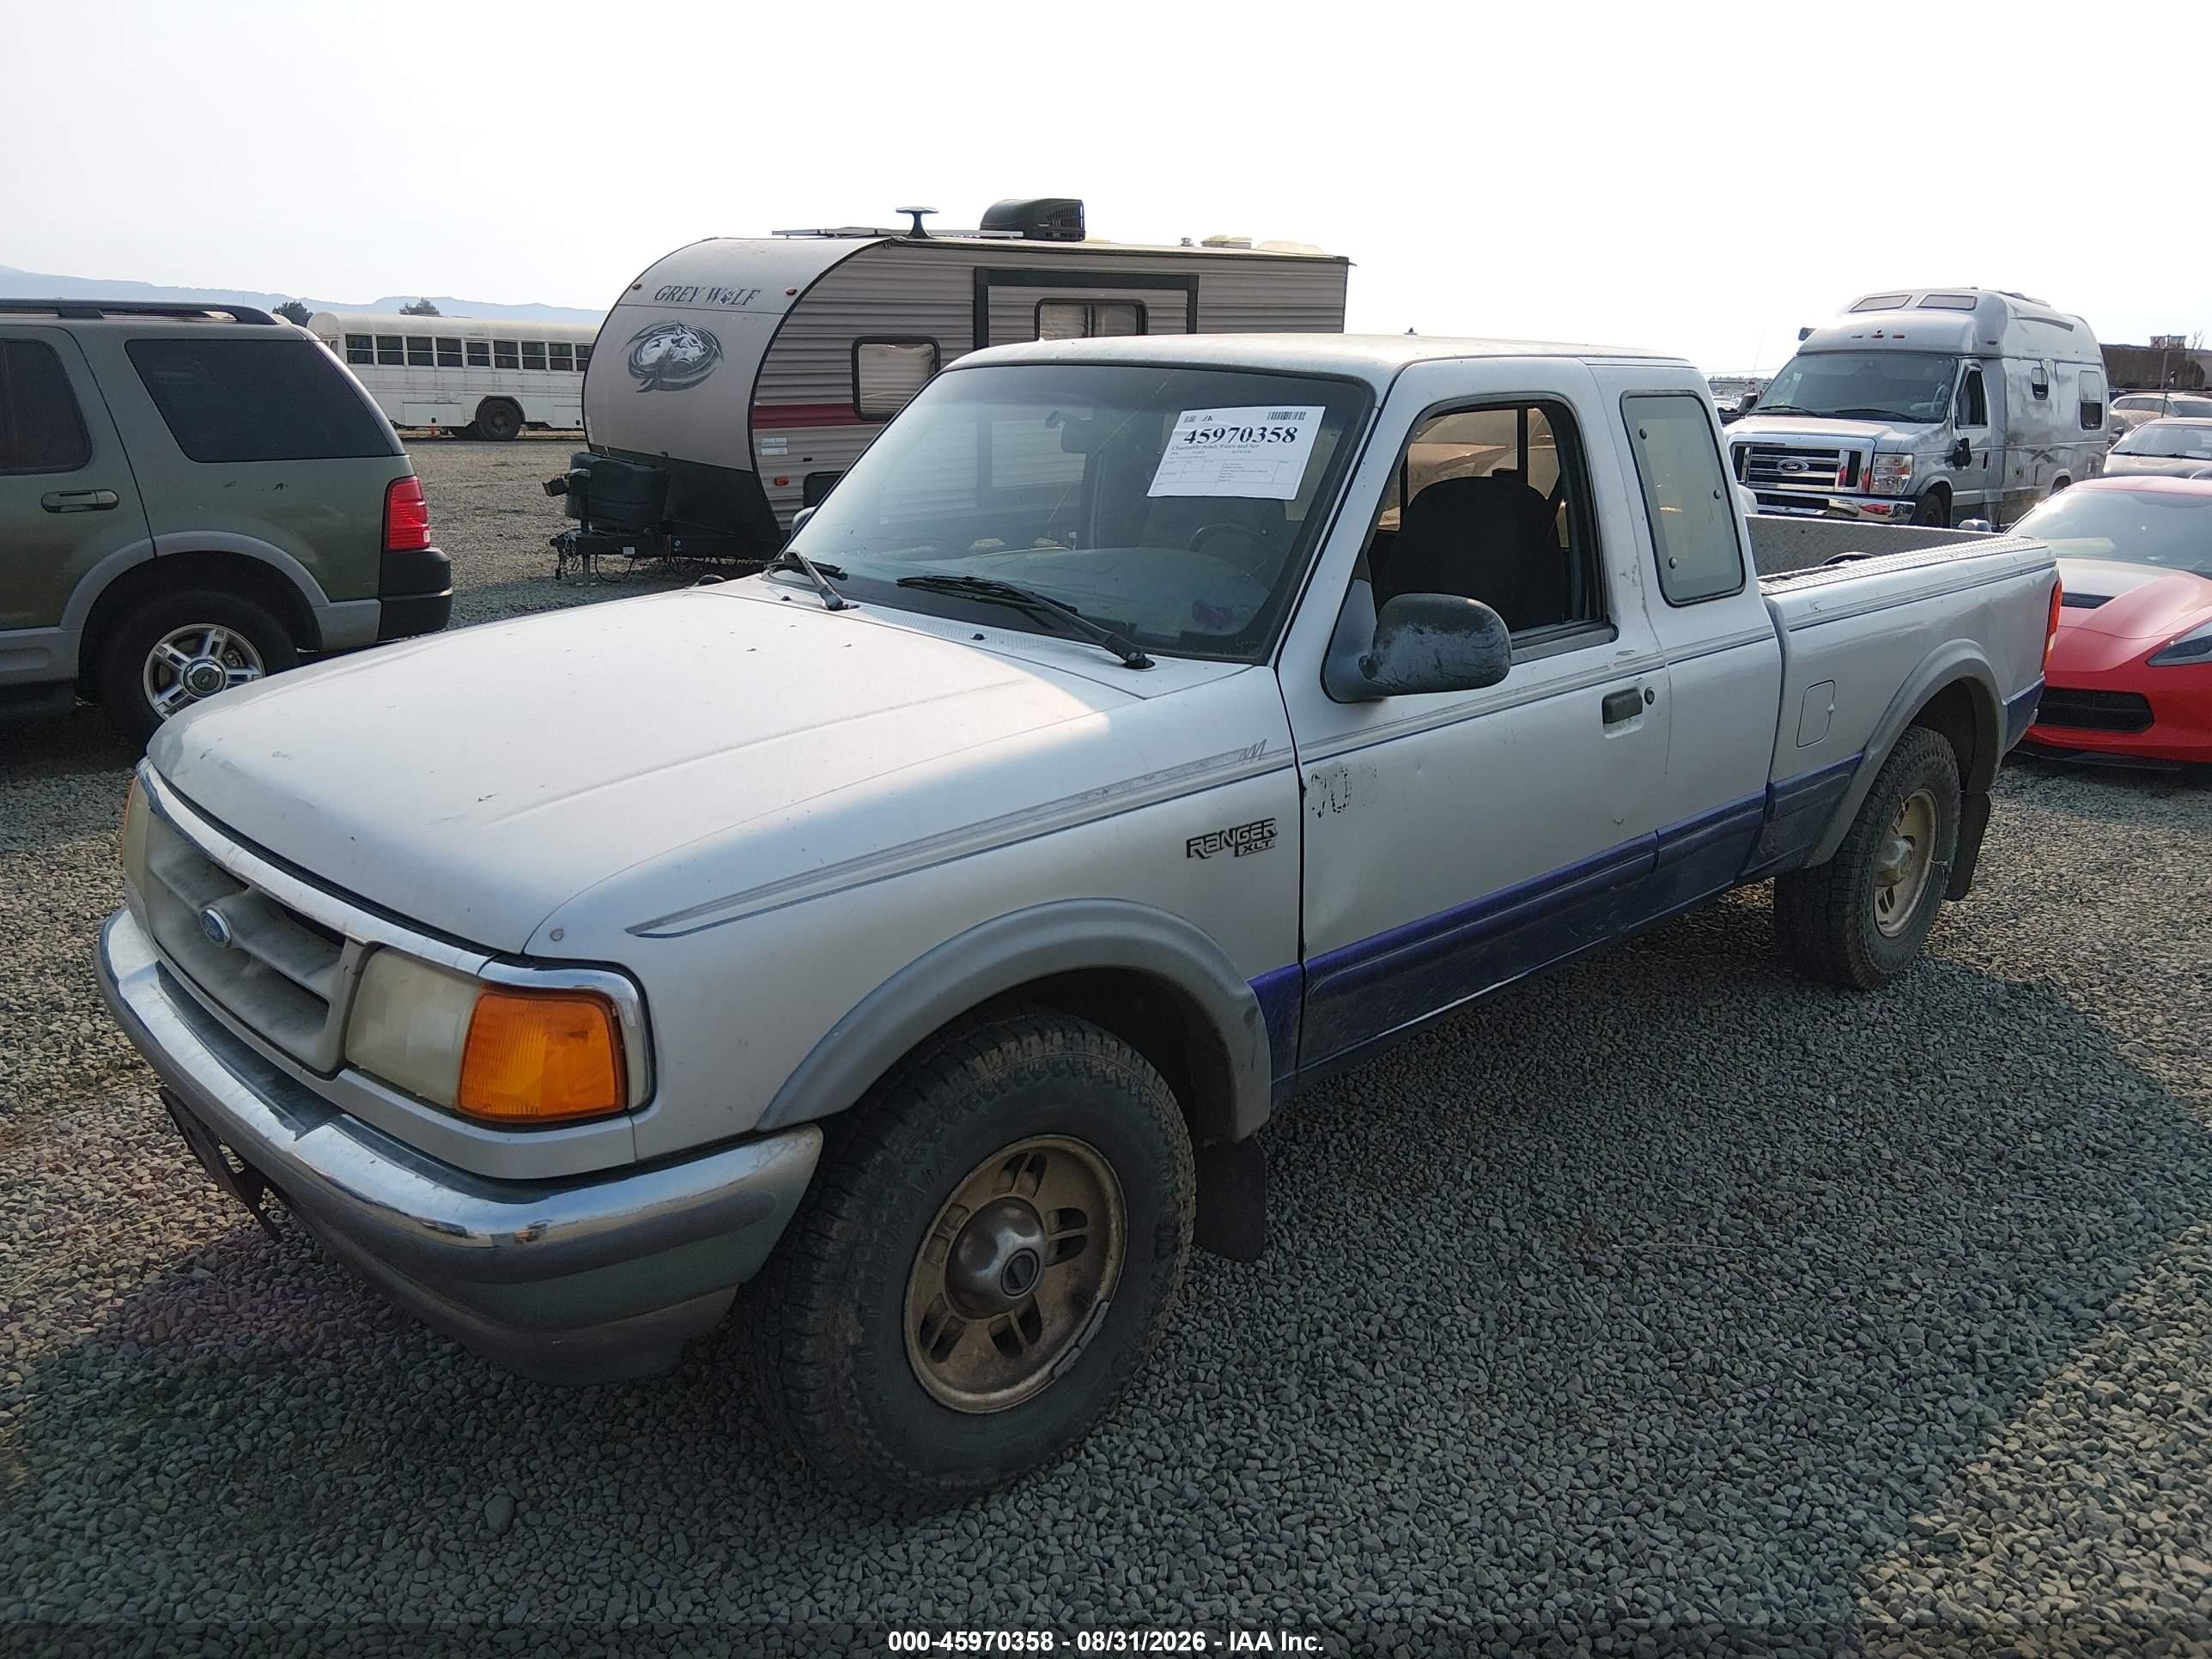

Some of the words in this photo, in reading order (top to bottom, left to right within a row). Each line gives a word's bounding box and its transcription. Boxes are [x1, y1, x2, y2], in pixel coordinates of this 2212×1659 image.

[654, 285, 707, 303] GREY
[1183, 426, 1298, 445] 45970358
[1186, 817, 1279, 860] RANGER
[1242, 839, 1273, 854] XLT
